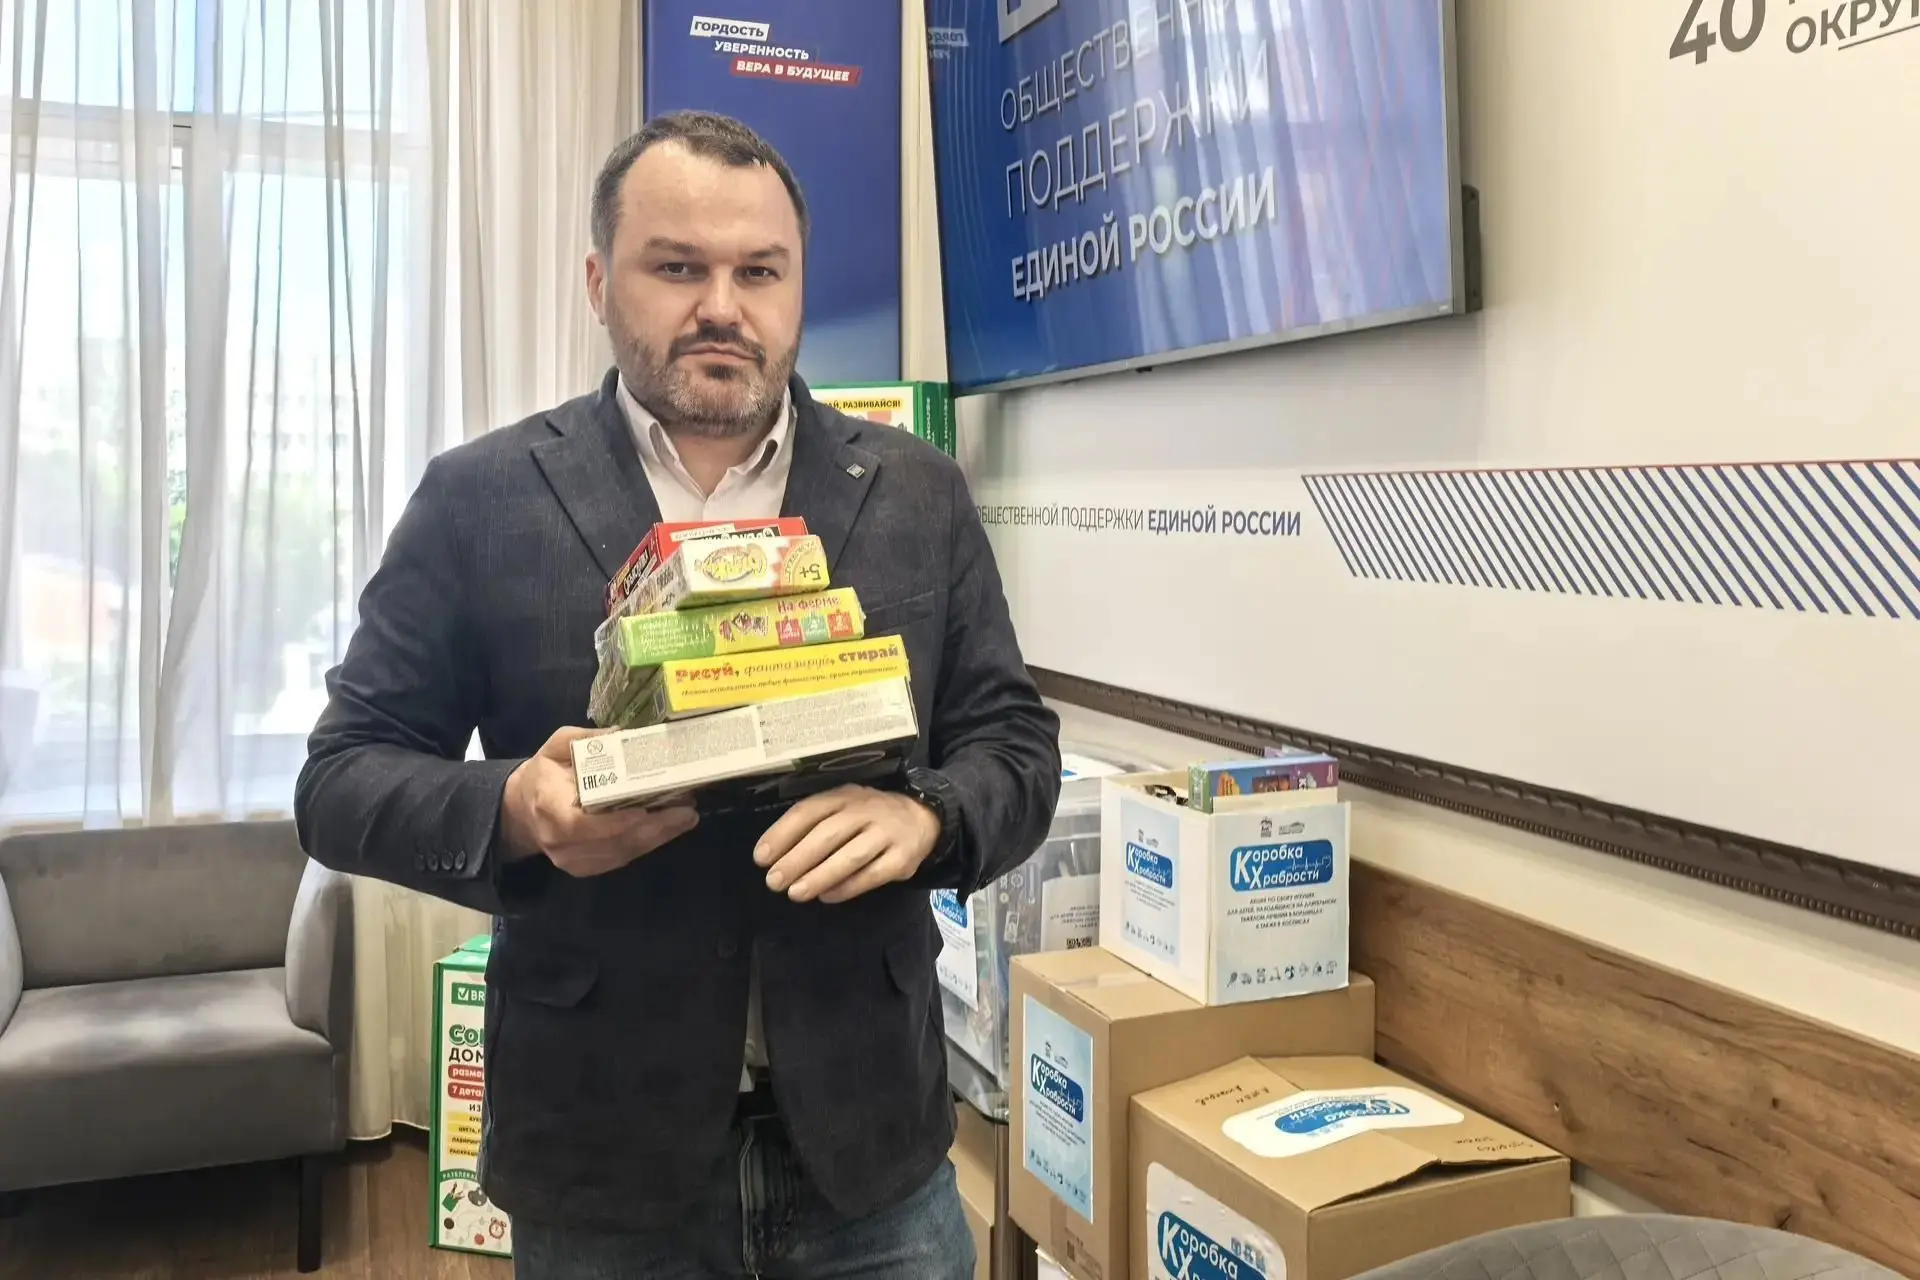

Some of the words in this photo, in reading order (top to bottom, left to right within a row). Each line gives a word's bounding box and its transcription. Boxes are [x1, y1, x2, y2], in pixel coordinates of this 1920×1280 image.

[693, 21, 765, 37] ГОРДОСТЬ
[1669, 0, 1766, 65] 40
[714, 40, 810, 60] УВЕРЕННОСТЬ
[736, 60, 771, 74] ВЕРА
[774, 64, 784, 75] В
[786, 66, 850, 82] БУДУЩЕЕ
[1005, 45, 1270, 217] ПОДДЕРЖКИ
[1011, 213, 1121, 300] ЕДИНОЙ
[1129, 166, 1278, 263] РОССИИ
[843, 398, 901, 409] РАЗВИВАЙСЯ!
[1062, 507, 1144, 533] ПОДДЕРЖКИ
[1148, 505, 1216, 535] ЕДИНОЙ
[1222, 510, 1301, 536] РОССИИ
[799, 563, 822, 581] 5+
[675, 661, 739, 684] Рисуй,
[838, 645, 899, 664] стирай
[1234, 844, 1304, 884] Коробка
[1249, 862, 1320, 889] Храбрости
[1032, 1057, 1068, 1089] Коробка
[452, 1086, 458, 1094] 7
[1162, 1216, 1238, 1279] Коробка
